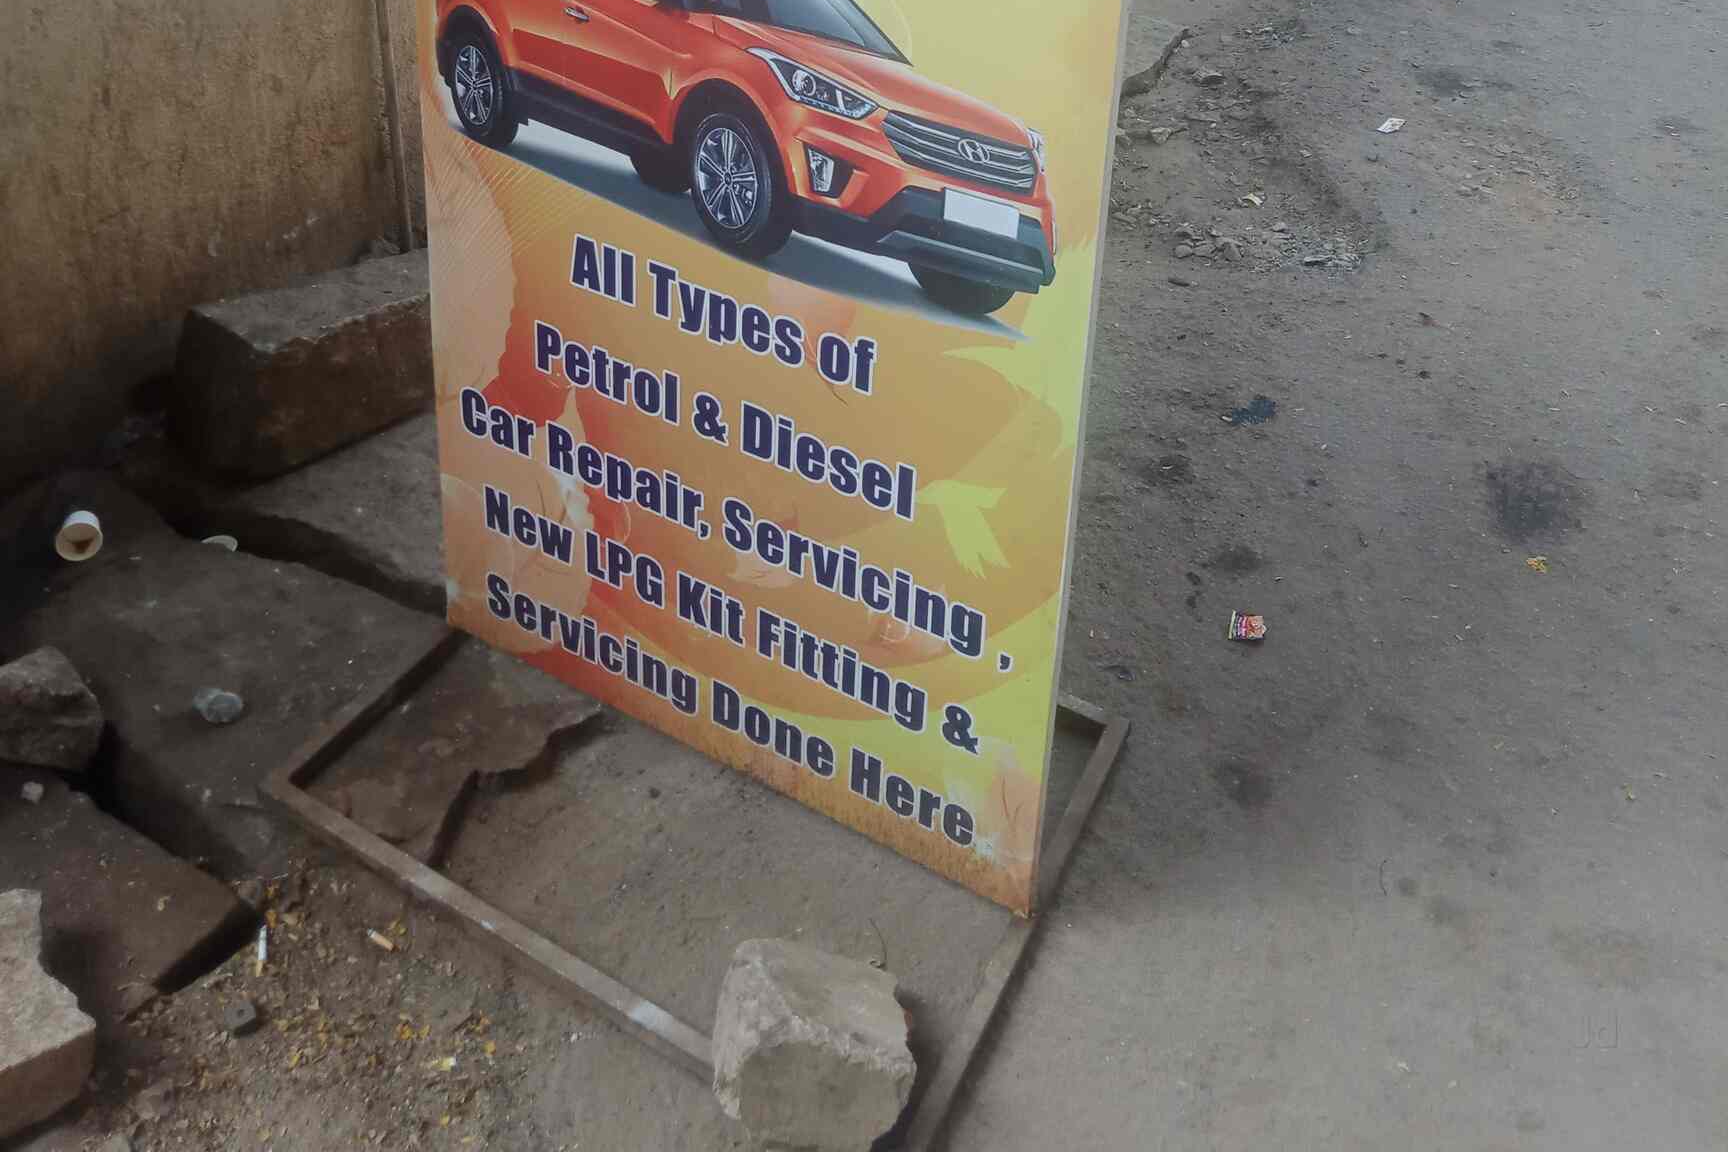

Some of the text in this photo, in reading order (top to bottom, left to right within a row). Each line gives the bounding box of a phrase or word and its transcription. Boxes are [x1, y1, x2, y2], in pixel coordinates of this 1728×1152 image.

[571, 234, 876, 394] All Types of
[461, 387, 537, 457] Car
[547, 418, 710, 539] Repair,
[534, 320, 917, 521] Petrol & Diesel
[484, 485, 982, 757] New LPG Kit Fitting &
[487, 574, 976, 848] Servicing Done Here
